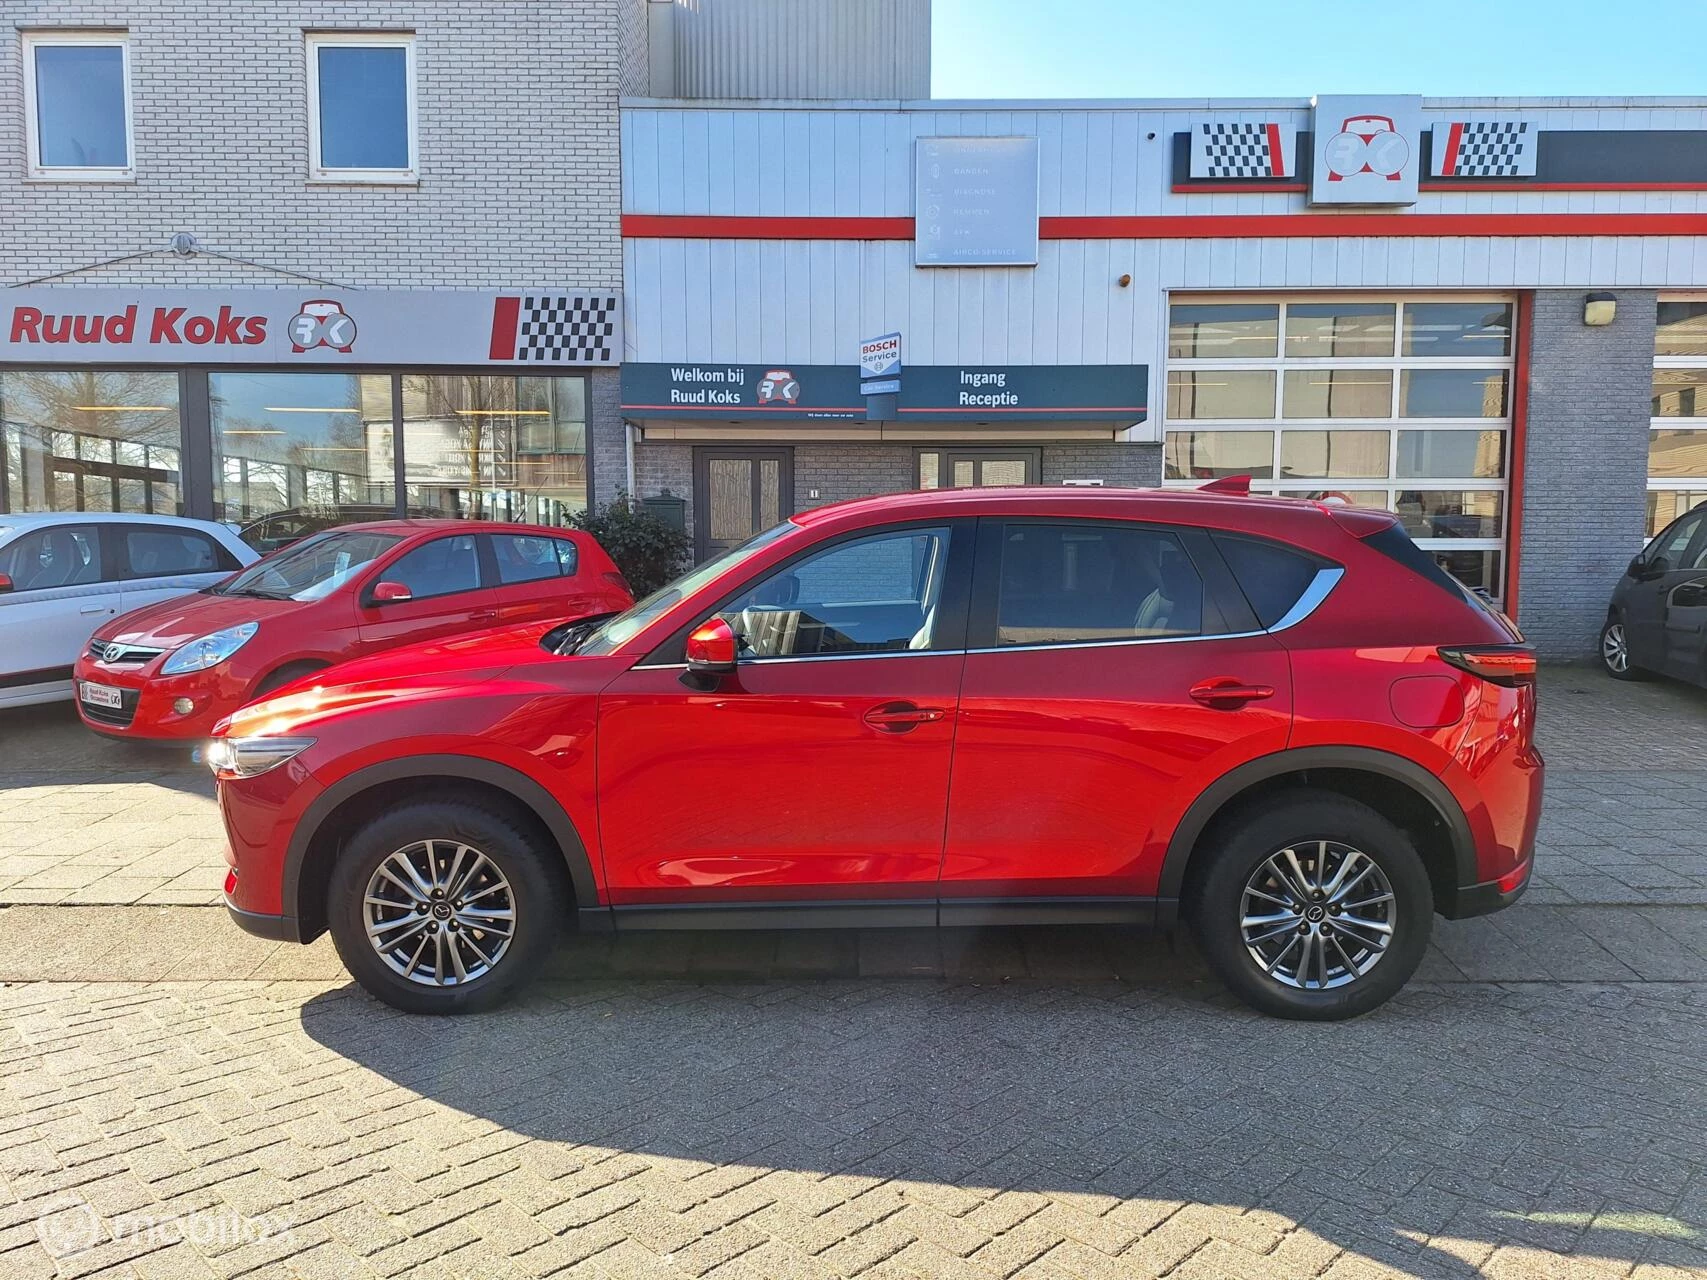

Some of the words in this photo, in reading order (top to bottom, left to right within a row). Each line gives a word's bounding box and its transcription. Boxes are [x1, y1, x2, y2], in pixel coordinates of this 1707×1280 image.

[9, 305, 138, 344] Ruud
[149, 305, 267, 344] Koks
[862, 340, 897, 354] BOSCH
[862, 351, 897, 363] Service
[670, 367, 725, 382] Welkom
[727, 368, 745, 386] bij
[960, 370, 1006, 387] Ingang
[670, 389, 705, 403] Ruud
[708, 389, 741, 403] Koks
[959, 391, 1019, 408] Receptie
